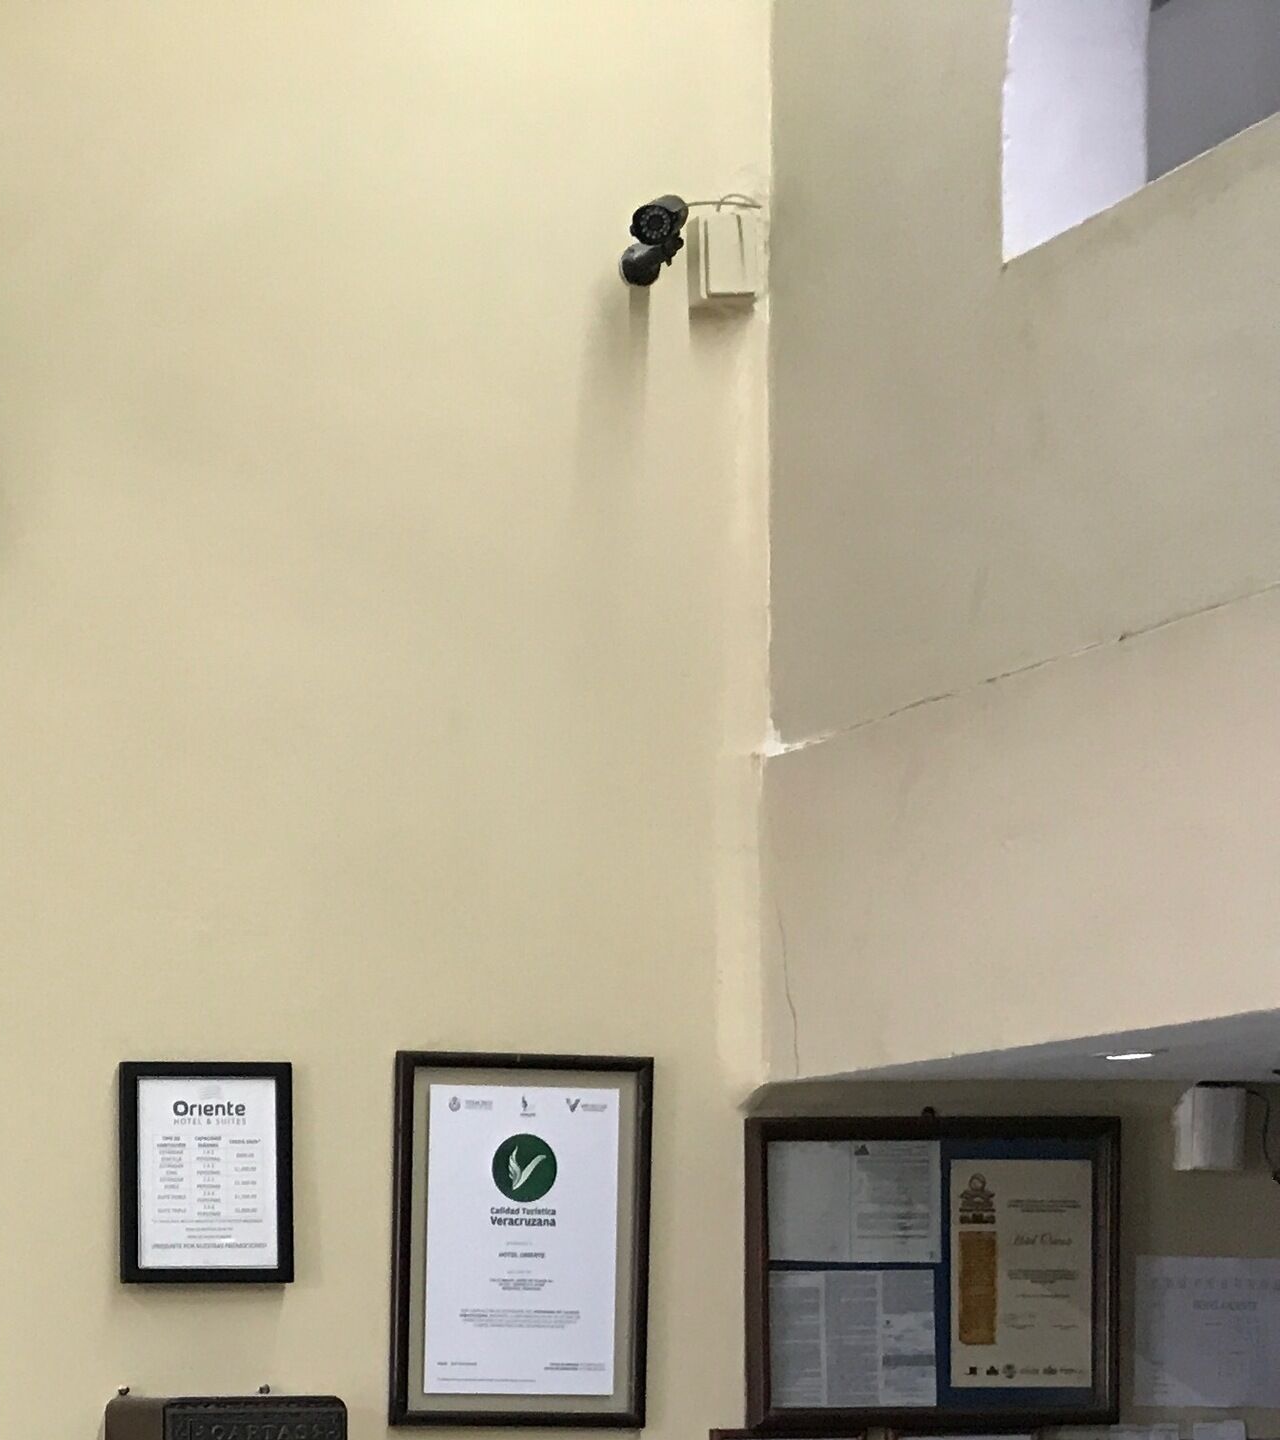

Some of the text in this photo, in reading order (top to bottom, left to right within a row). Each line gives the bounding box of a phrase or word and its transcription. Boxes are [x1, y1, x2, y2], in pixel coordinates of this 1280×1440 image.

[173, 1100, 246, 1116] Oriente
[490, 1207, 520, 1215] Calidad
[490, 1216, 557, 1227] Veracruzana
